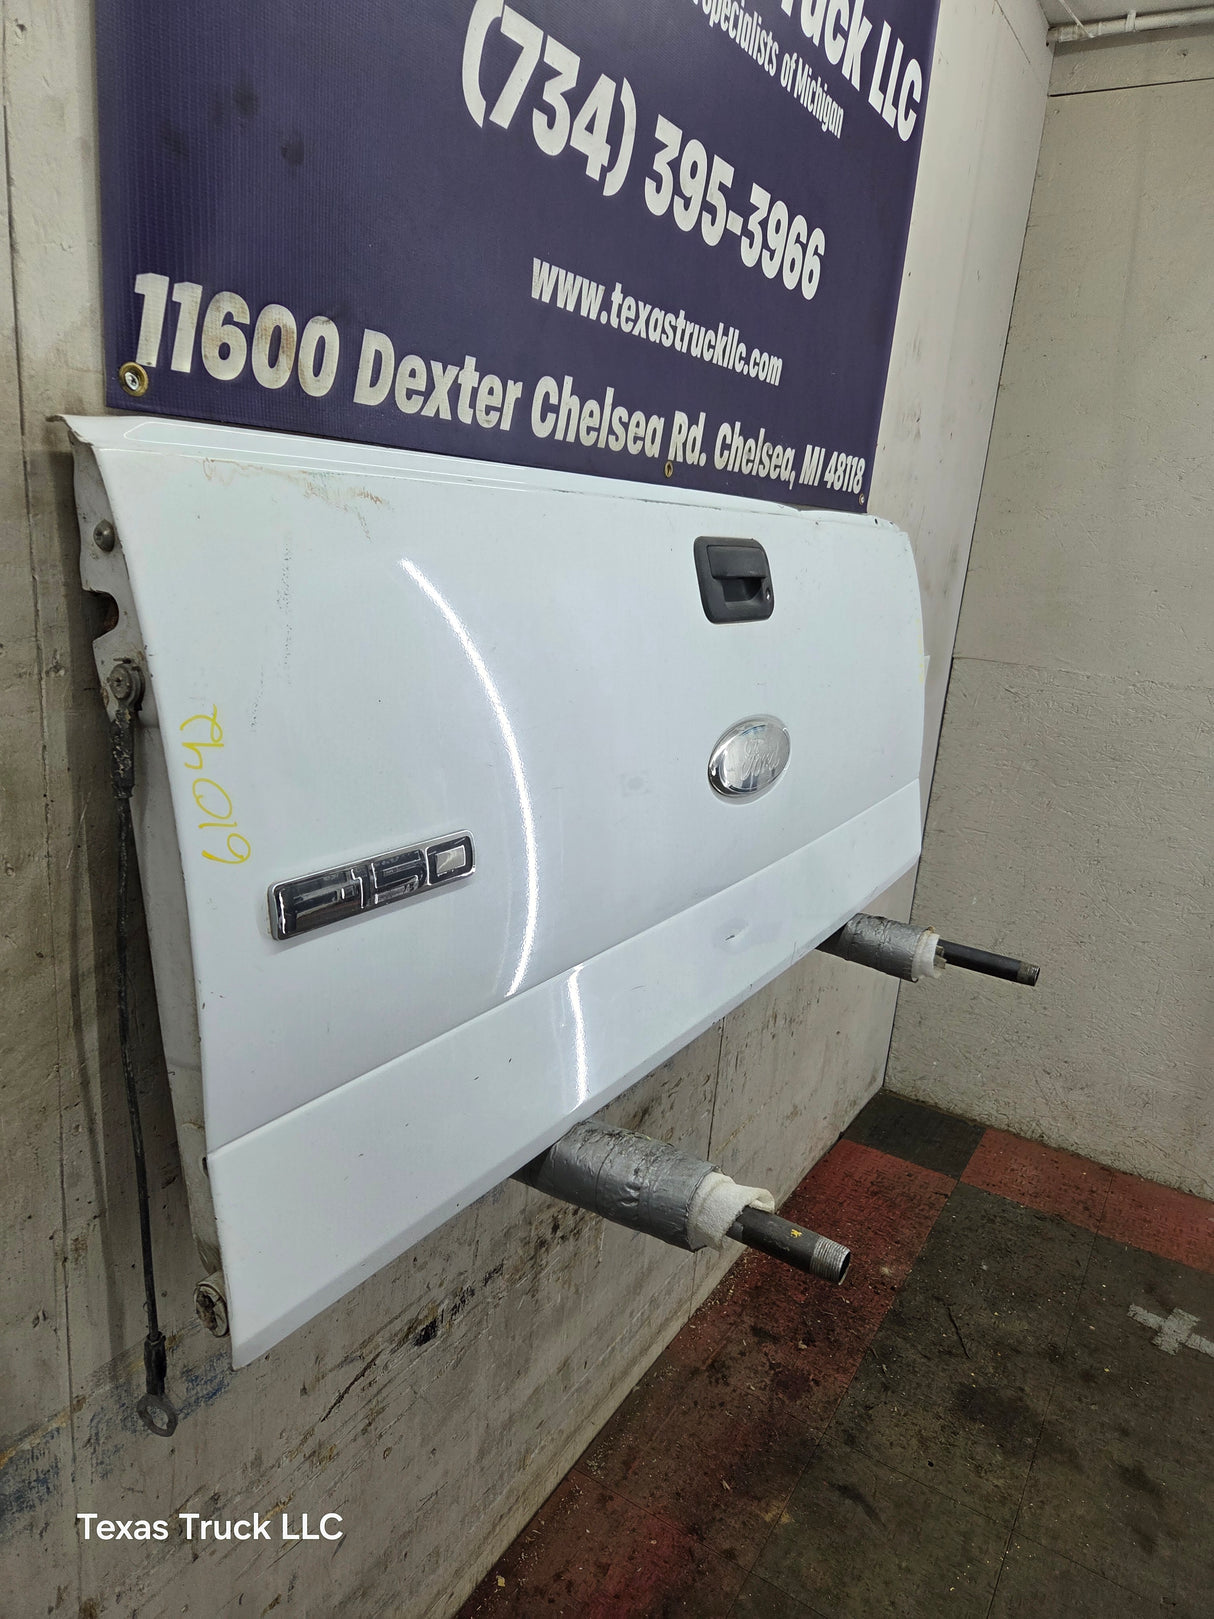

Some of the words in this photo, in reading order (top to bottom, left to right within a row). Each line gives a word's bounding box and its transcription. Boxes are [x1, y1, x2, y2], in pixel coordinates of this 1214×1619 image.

[780, 52, 798, 92] of
[793, 57, 844, 139] Michigan
[781, 0, 873, 92] uck
[868, 20, 923, 142] LLC
[462, 0, 637, 197] (734)
[644, 114, 826, 300] 395-3966
[134, 272, 340, 397] 11600
[353, 328, 523, 431] Dexter
[531, 375, 665, 458] Chelsea
[667, 410, 707, 467] Rd.
[714, 421, 796, 490] Chelsea,
[799, 444, 830, 487] MI
[824, 451, 866, 494] 48118
[531, 257, 783, 386] www.texastruckllc.com
[180, 704, 251, 864] 61042
